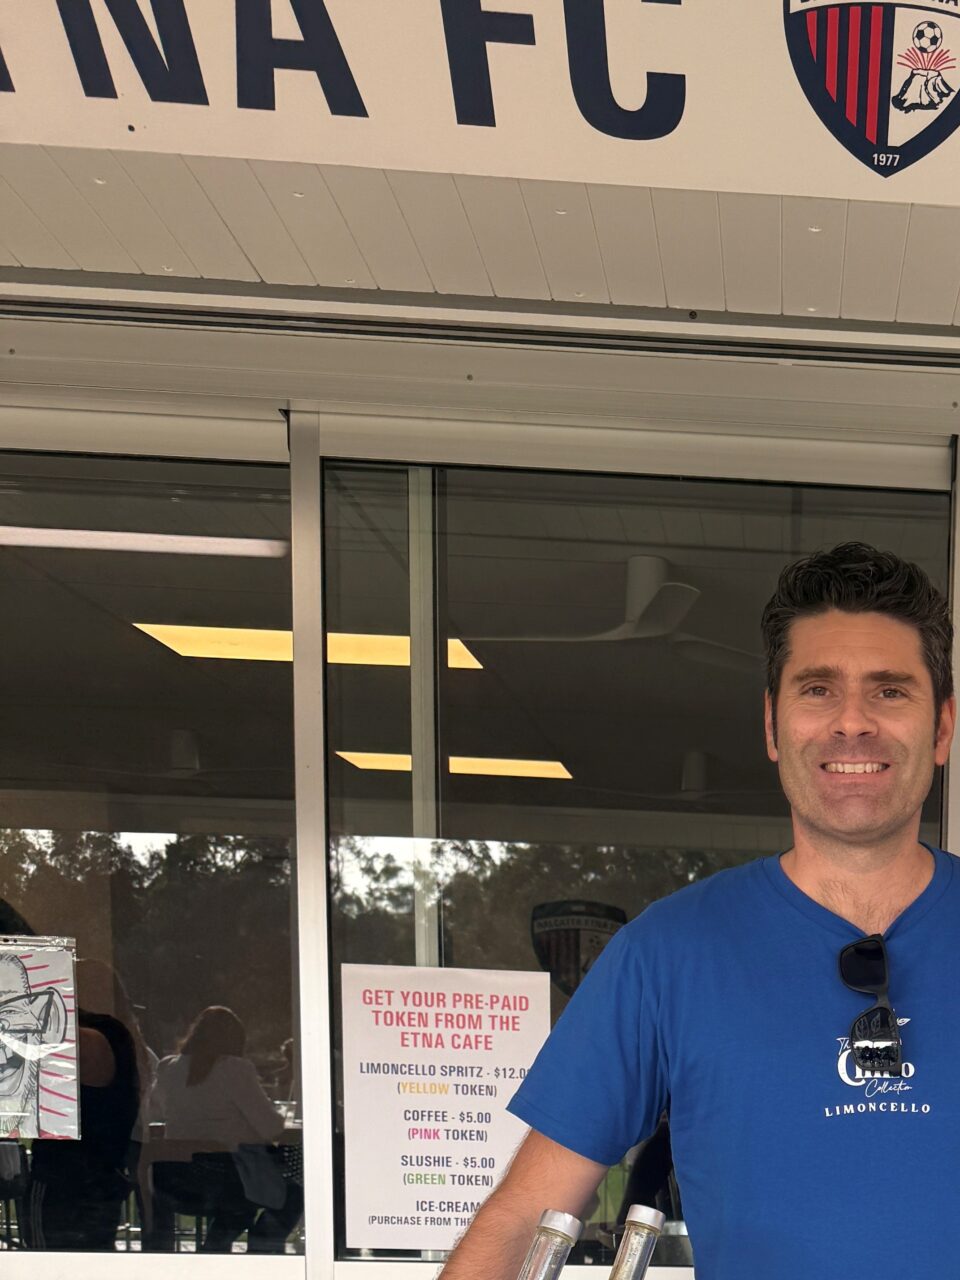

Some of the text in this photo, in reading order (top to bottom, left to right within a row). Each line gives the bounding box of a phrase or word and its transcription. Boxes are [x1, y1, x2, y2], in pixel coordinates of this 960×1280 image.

[0, 0, 687, 141] NA FC
[872, 153, 900, 167] 1977
[362, 989, 529, 1011] GET YOUR PRE-PAID
[372, 1010, 520, 1031] TOKEN FROM THE
[401, 1031, 493, 1050] ETNA CAFE
[360, 1062, 436, 1077] LIMONCELLO
[440, 1064, 483, 1078] SPRITZ
[397, 1082, 498, 1098] (YELLOW TOKEN)
[403, 1109, 448, 1123] COFFEE
[459, 1111, 491, 1124] $5.00
[824, 1102, 931, 1117] LIMONCELLO
[408, 1127, 488, 1143] (PINK TOKEN)
[401, 1155, 452, 1168] SLUSHIE
[463, 1156, 495, 1169] $5.00
[403, 1173, 494, 1188] (GREEN TOKEN)
[416, 1200, 481, 1213] ICE-CREAM
[368, 1215, 422, 1227] (PURCHASE
[424, 1216, 452, 1227] FROM
